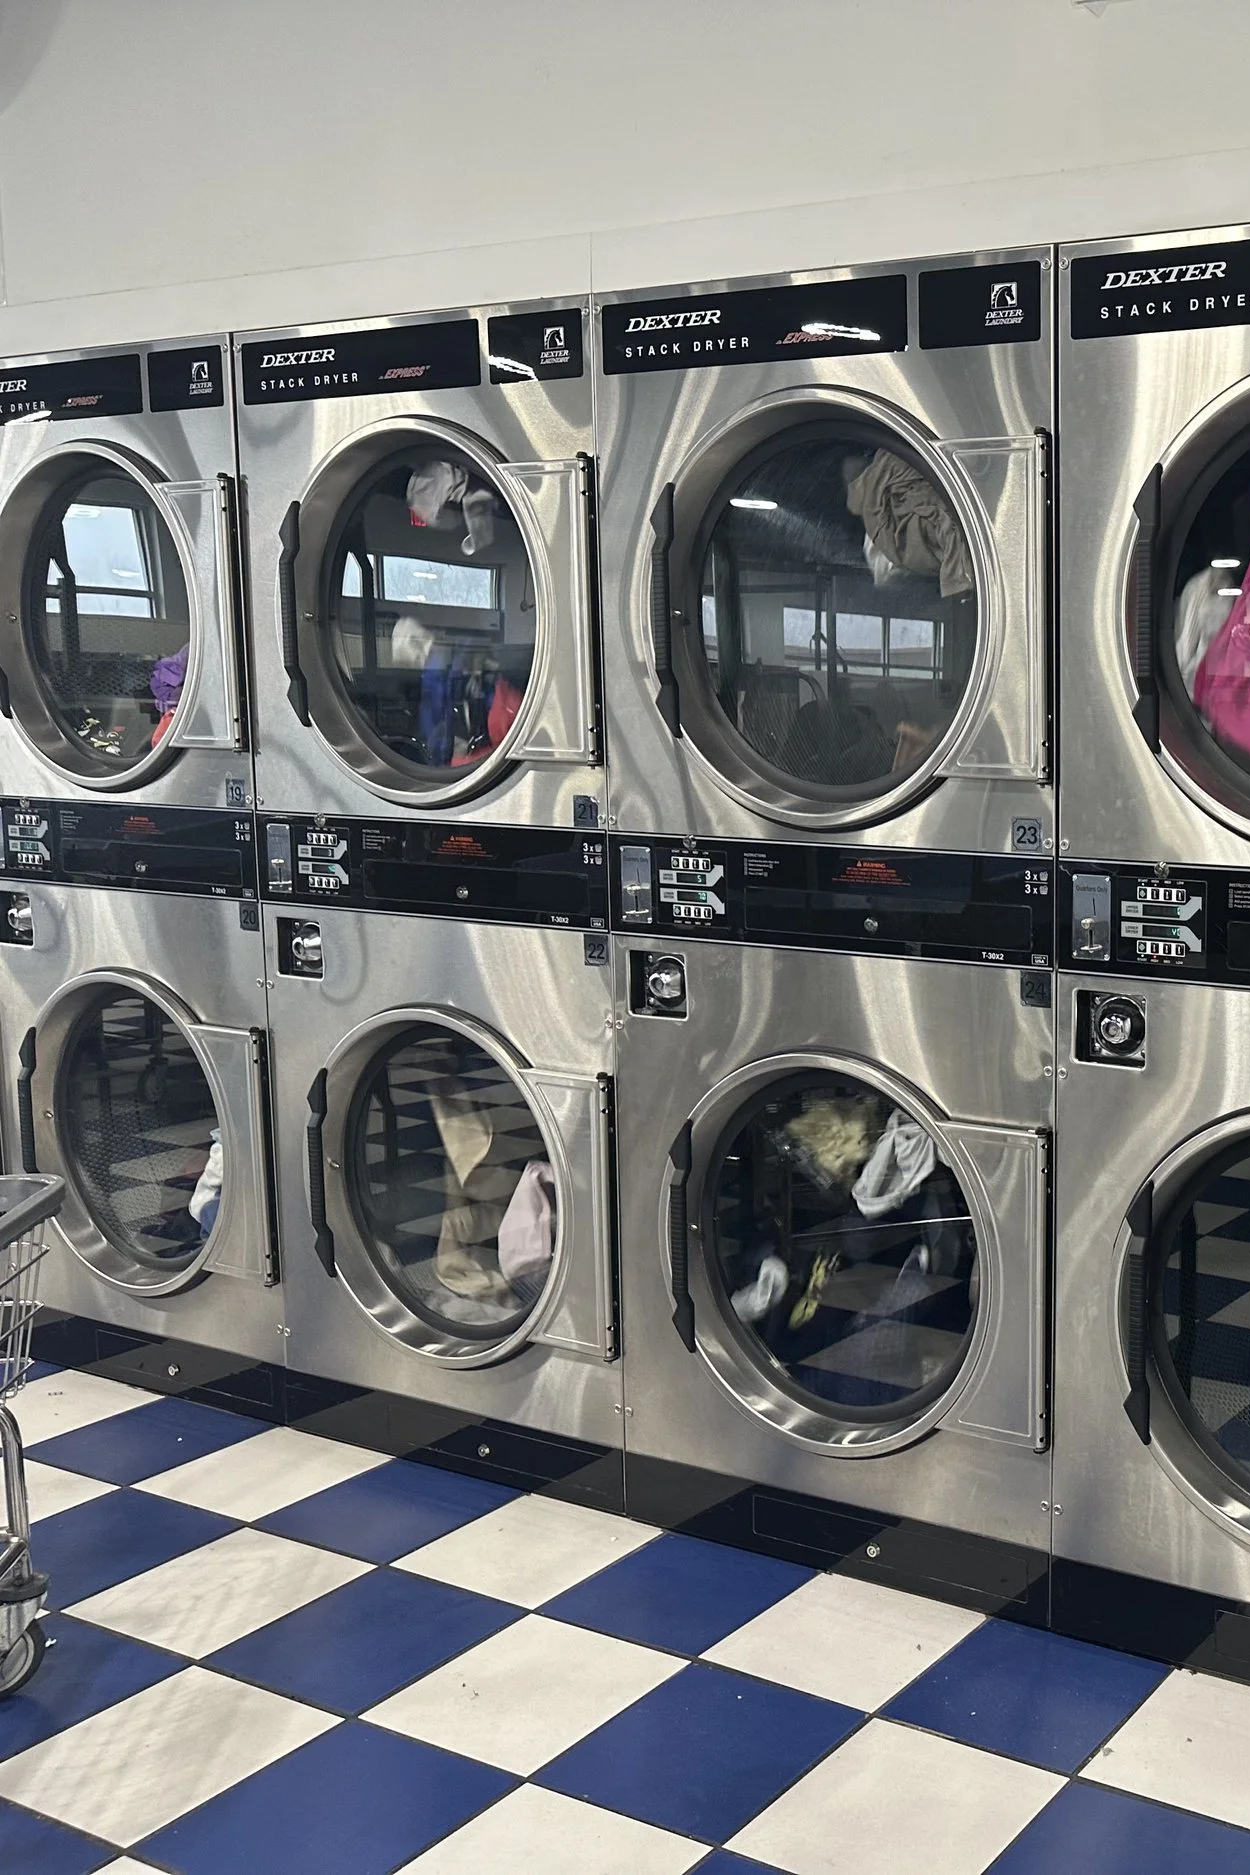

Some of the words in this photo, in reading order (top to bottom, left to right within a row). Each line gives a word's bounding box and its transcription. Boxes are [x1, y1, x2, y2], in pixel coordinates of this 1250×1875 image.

[1100, 261, 1227, 290] DEXTER
[984, 309, 1023, 320] DEXTER
[1100, 301, 1172, 319] STACK
[624, 310, 721, 332] DEXTER
[984, 316, 1024, 326] LAUNDRY
[540, 350, 569, 358] DEXTER
[626, 342, 680, 358] STACK
[693, 336, 749, 352] DRYER
[260, 348, 336, 368] DEXTER
[384, 365, 426, 380] EXPRESS
[0, 379, 27, 393] TER
[260, 378, 305, 390] STACK
[314, 372, 358, 386] DRYER
[10, 400, 47, 412] DRYER
[229, 786, 242, 800] 19
[578, 803, 594, 820] 21
[235, 821, 240, 830] 3
[236, 832, 240, 841] 3
[1016, 826, 1038, 844] 23
[583, 842, 588, 852] 3
[583, 855, 589, 864] 3
[1024, 870, 1031, 880] 3
[1024, 884, 1031, 894] 3
[242, 909, 256, 925] 20
[550, 916, 569, 924] T-30X2
[588, 942, 606, 960] 22
[982, 952, 1004, 960] T-30X2
[1025, 980, 1046, 1000] 24
